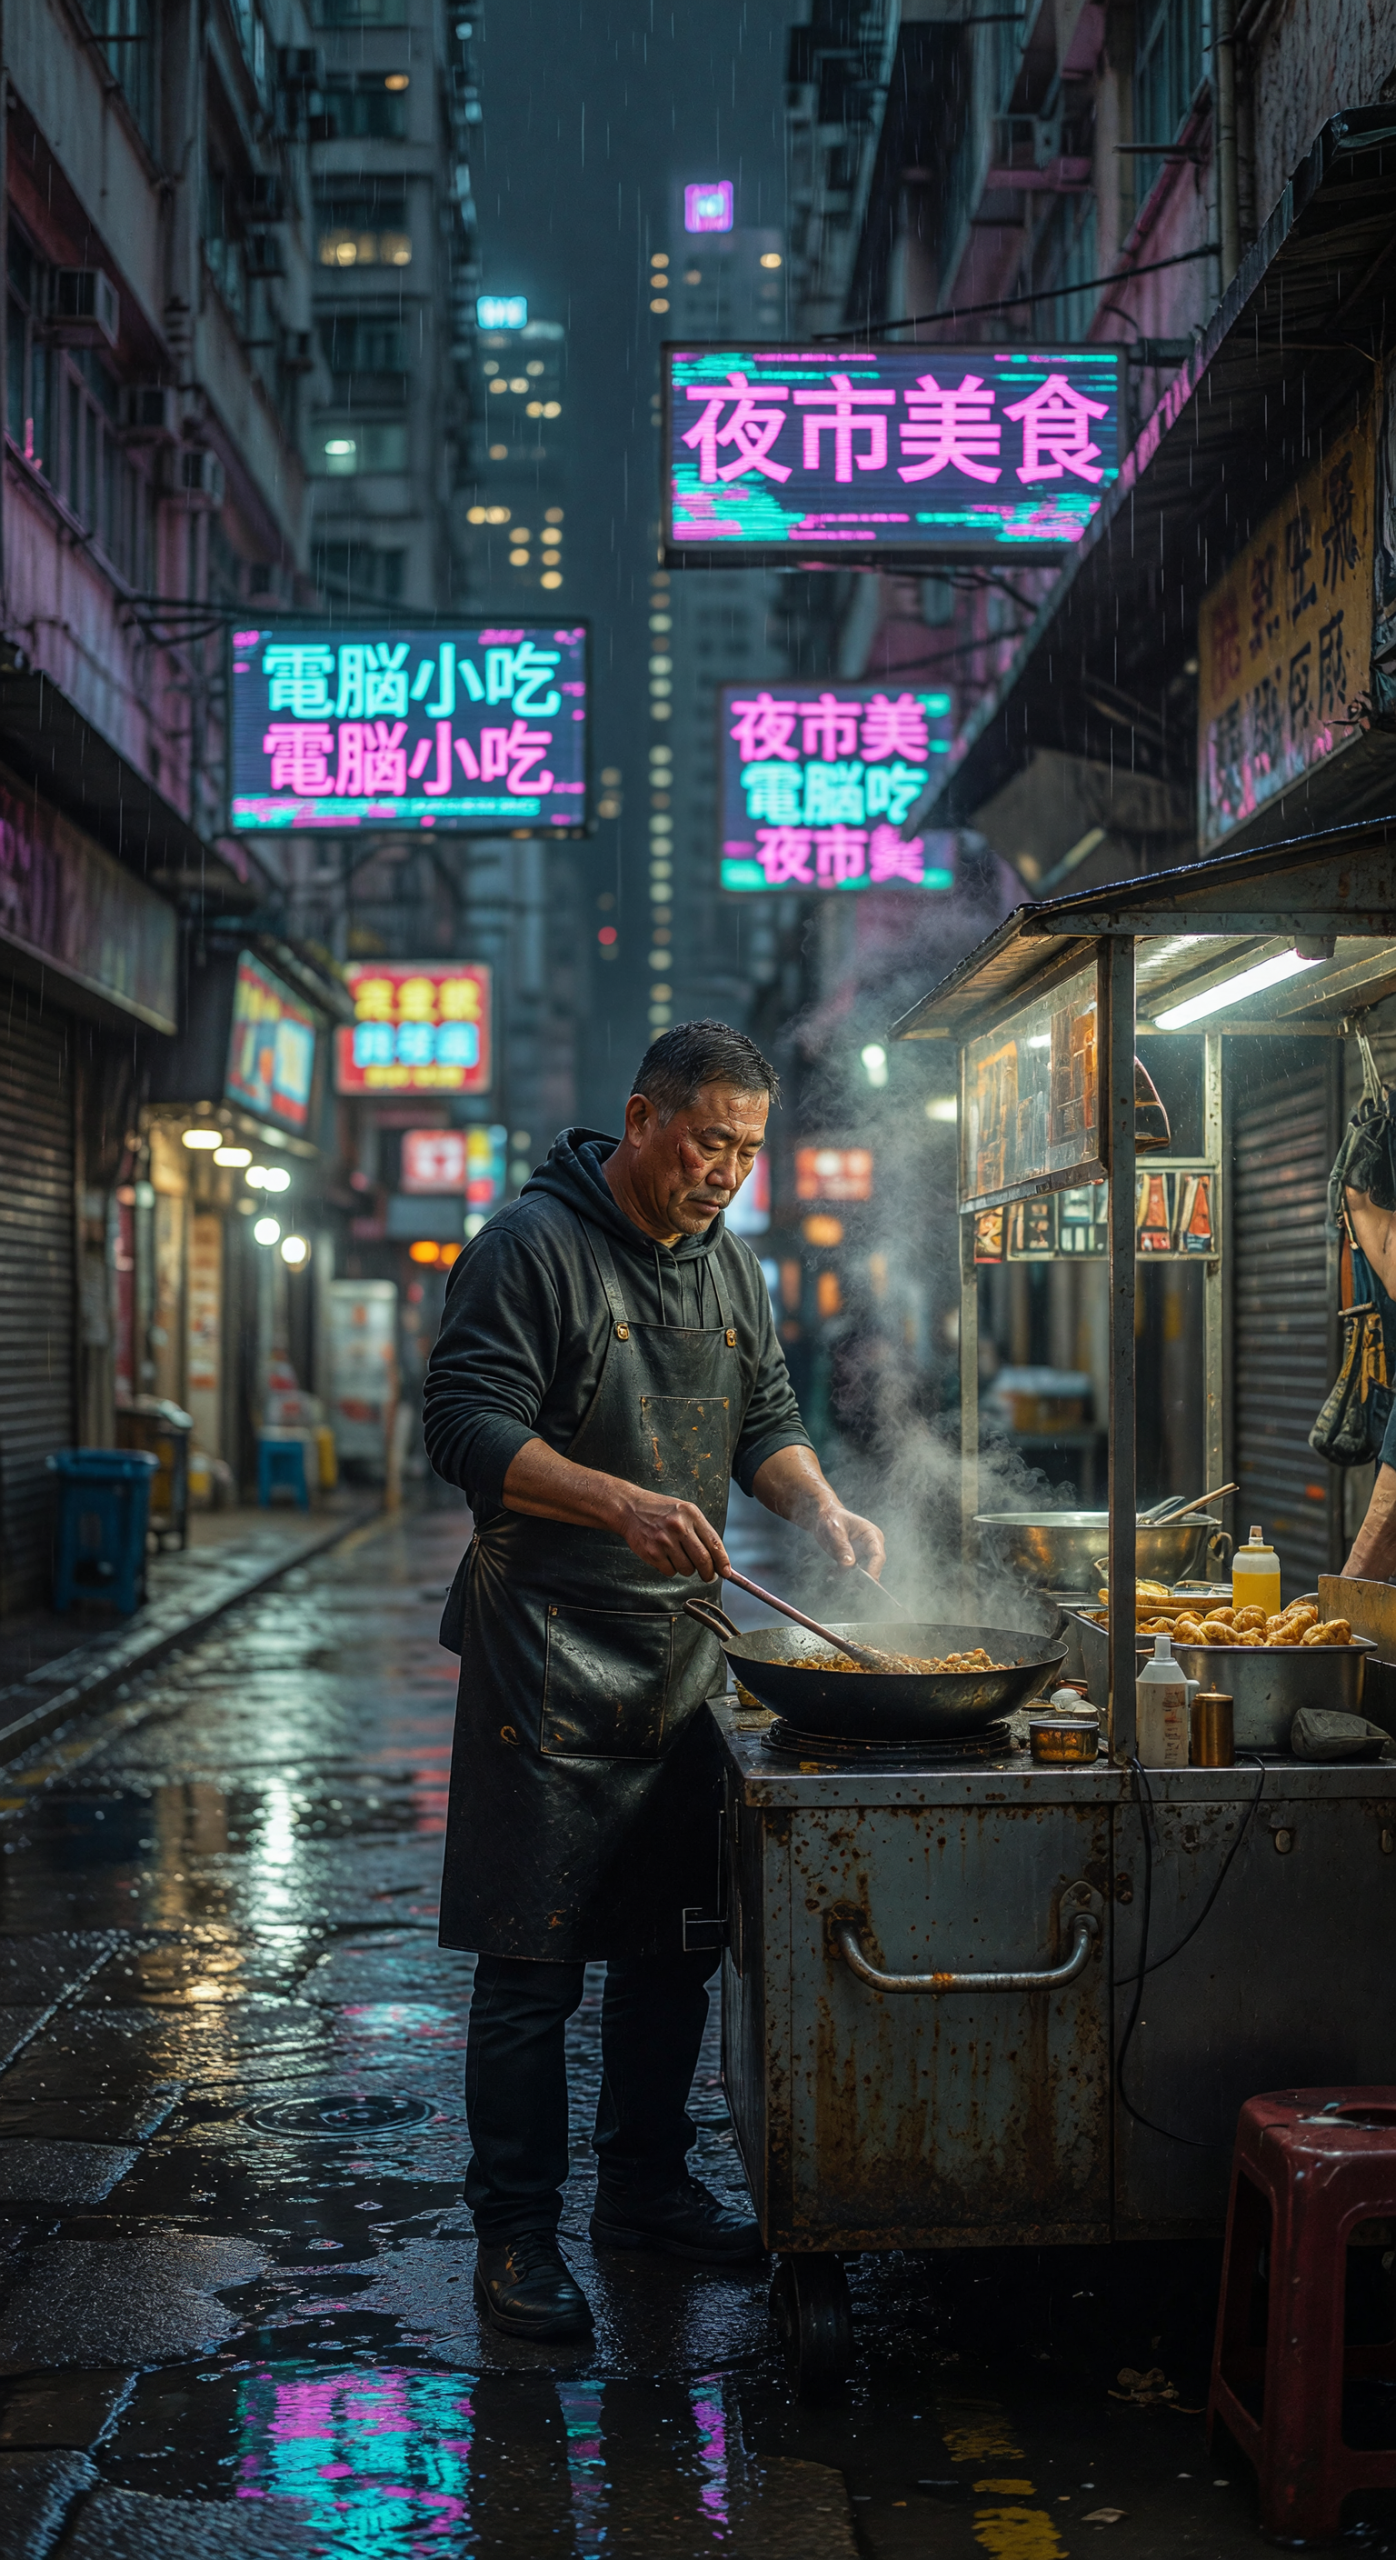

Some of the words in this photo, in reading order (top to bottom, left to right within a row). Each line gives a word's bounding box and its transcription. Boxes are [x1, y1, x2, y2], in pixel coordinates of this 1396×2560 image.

[681, 372, 1108, 484] 夜市美食
[729, 691, 930, 763] 夜市美
